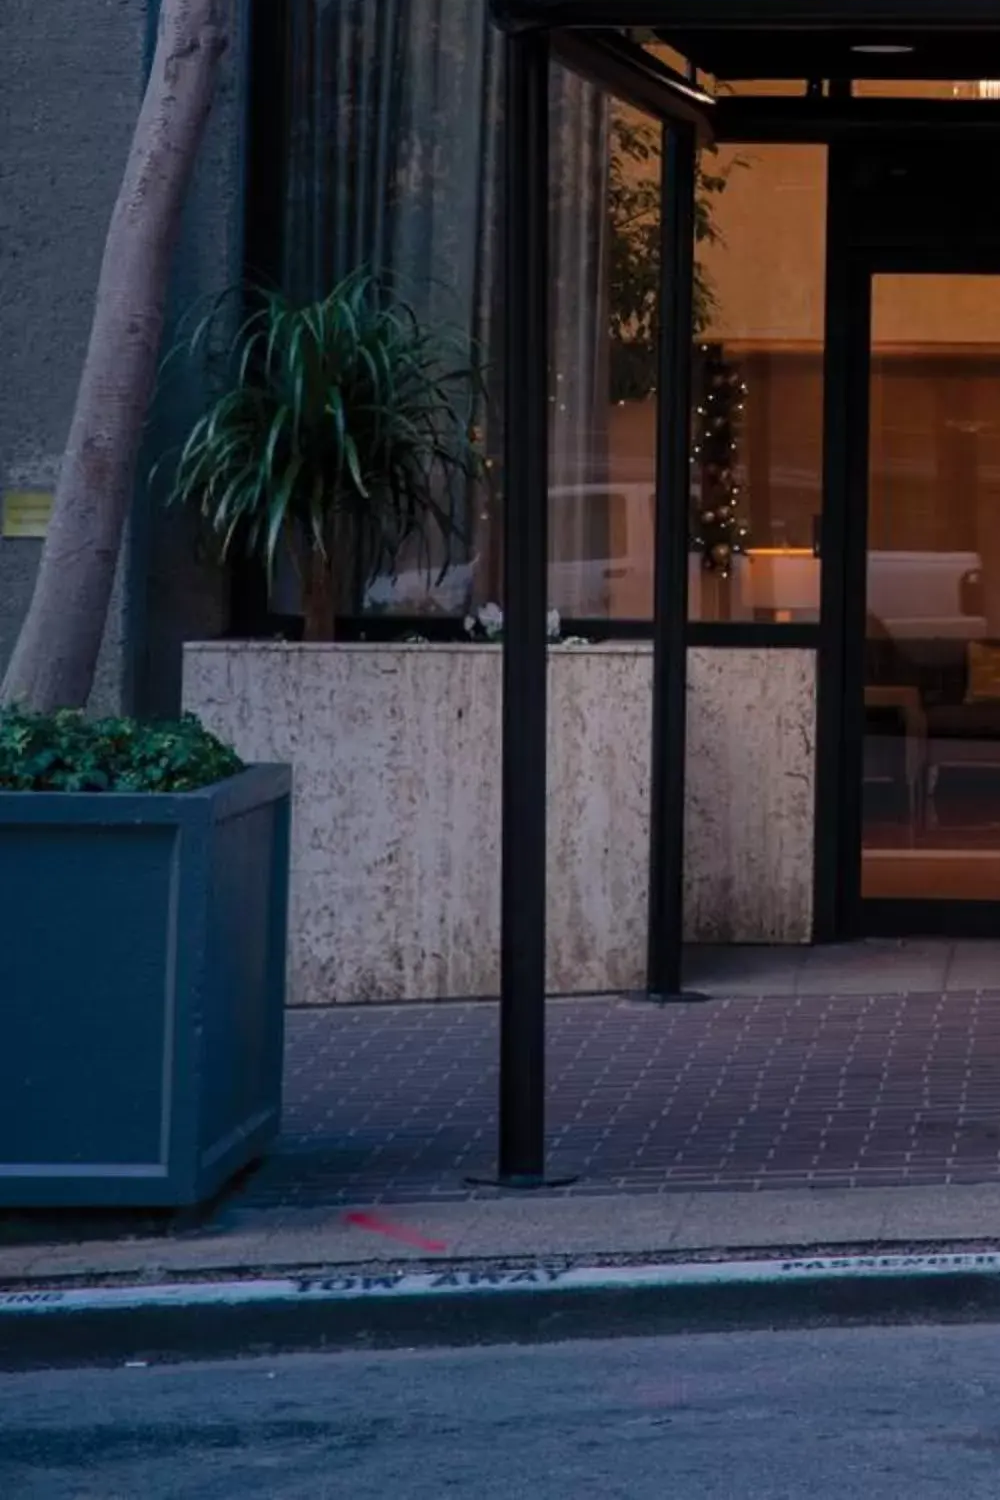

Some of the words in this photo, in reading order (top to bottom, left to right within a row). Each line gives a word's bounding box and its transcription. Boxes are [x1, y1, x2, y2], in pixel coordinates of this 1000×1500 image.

[781, 1255, 997, 1270] PASSENGER
[287, 1276, 406, 1292] TOW
[430, 1264, 573, 1287] AWAY
